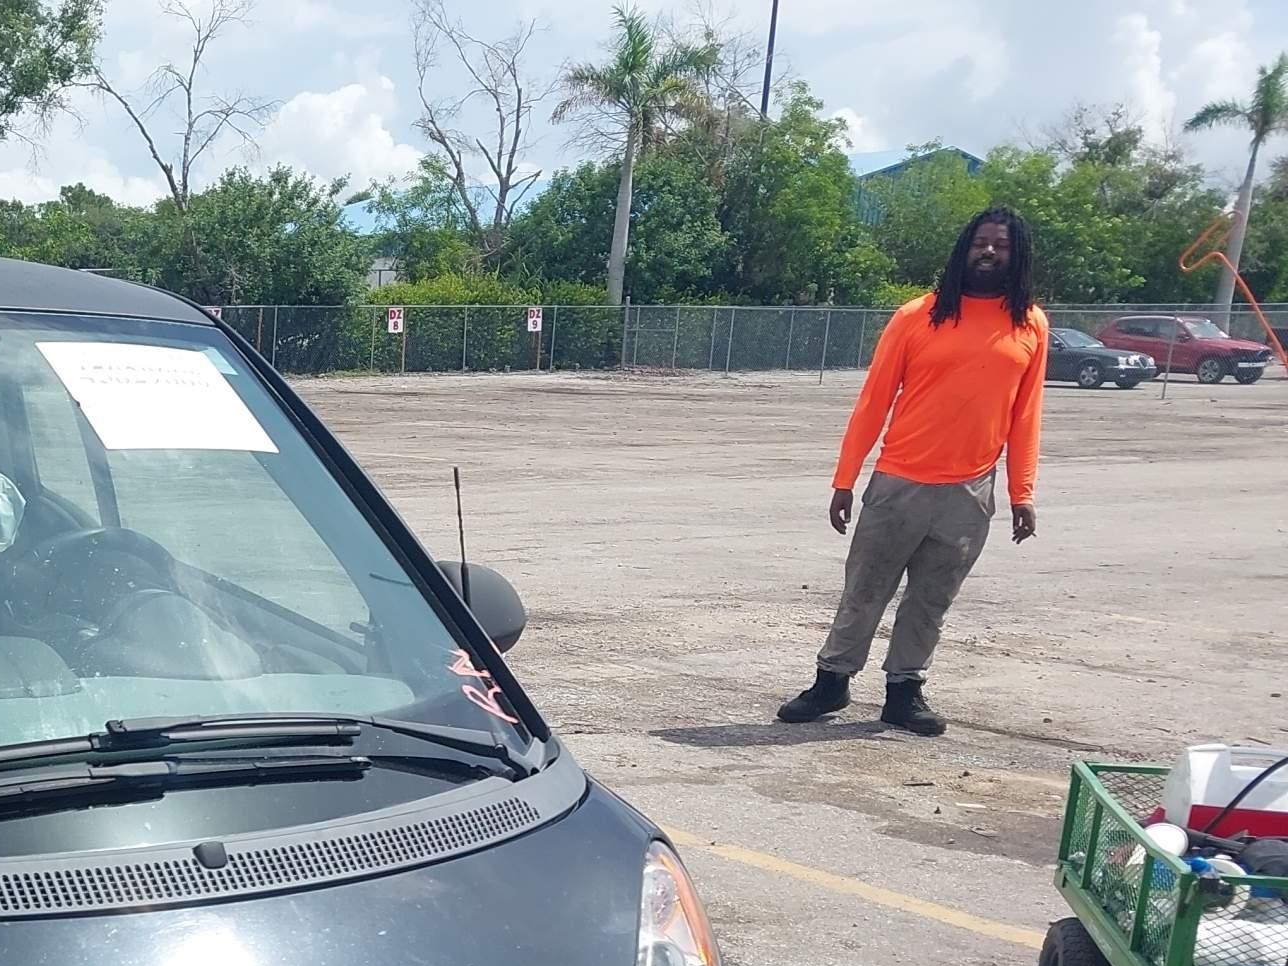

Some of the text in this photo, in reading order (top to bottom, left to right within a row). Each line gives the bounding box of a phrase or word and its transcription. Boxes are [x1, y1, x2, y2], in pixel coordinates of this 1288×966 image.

[389, 309, 402, 320] DZ
[529, 309, 541, 319] DZ
[532, 320, 538, 329] 9
